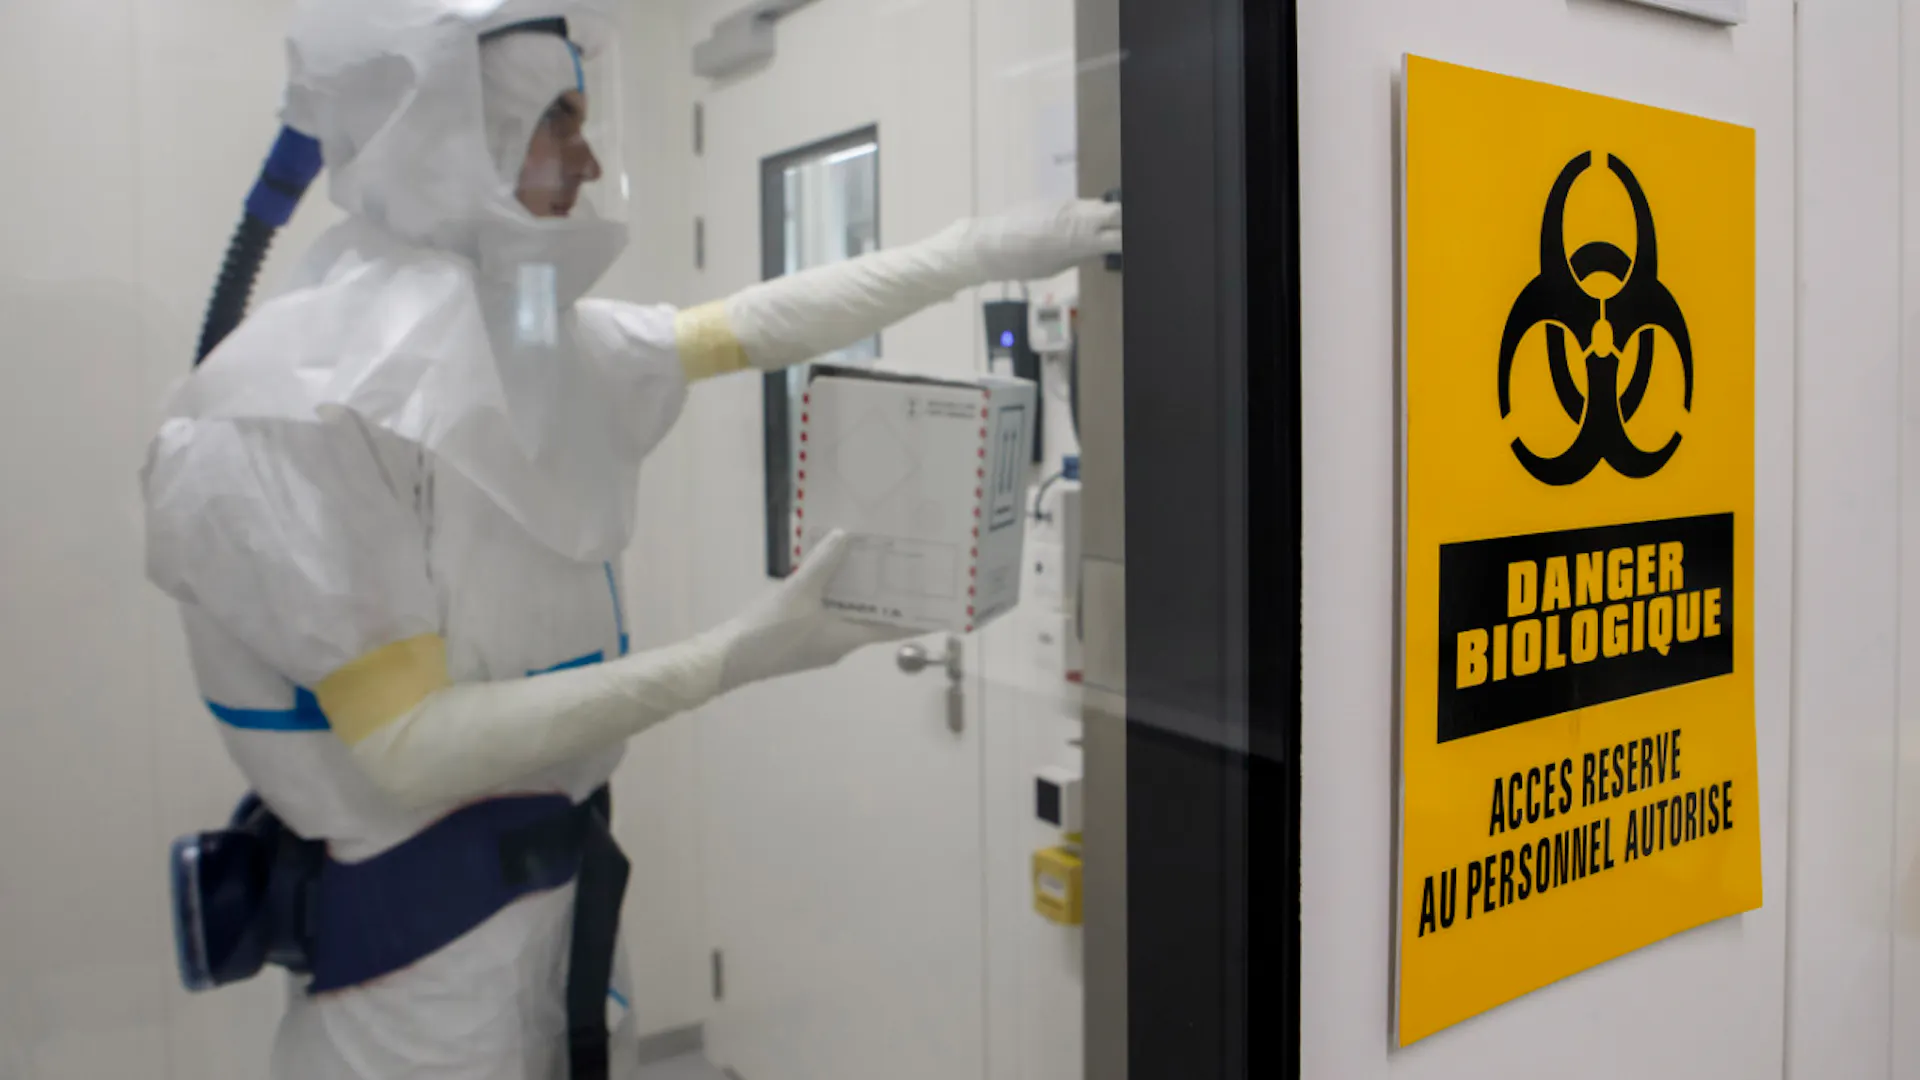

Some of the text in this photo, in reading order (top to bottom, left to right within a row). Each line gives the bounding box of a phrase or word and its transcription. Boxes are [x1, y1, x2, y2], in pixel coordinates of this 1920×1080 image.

[1507, 541, 1684, 618] DANGER
[1456, 587, 1721, 689] BIOLOGIQUE
[1489, 728, 1682, 837] ACCES RESERVE
[1417, 779, 1734, 938] AU PERSONNEL AUTORISE
